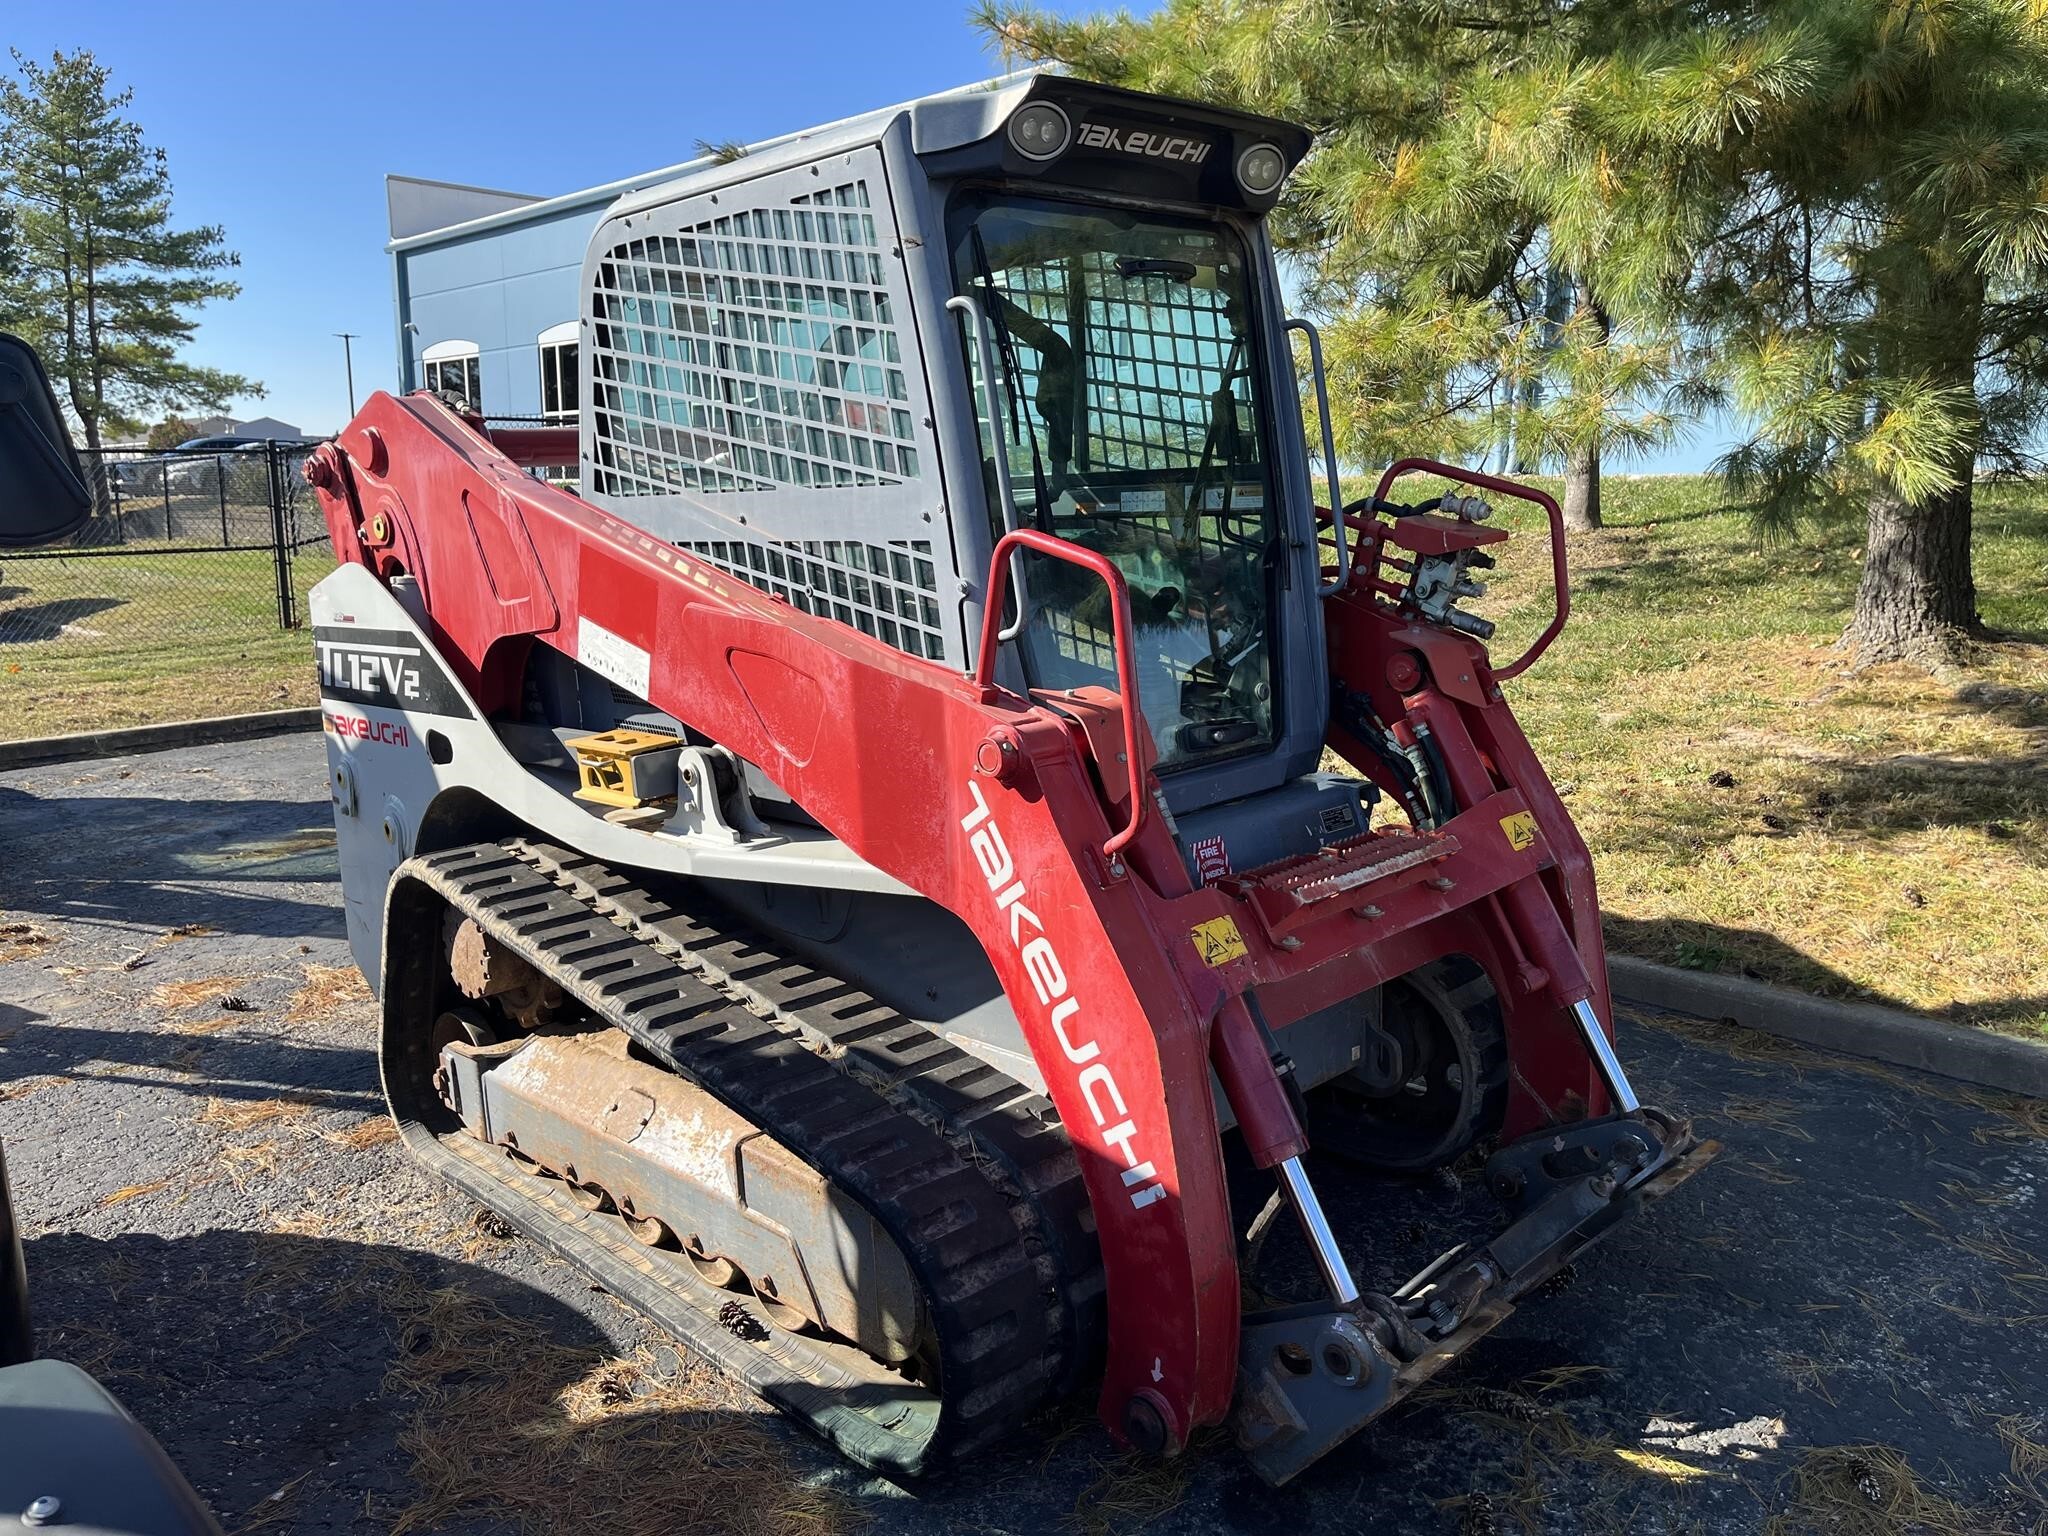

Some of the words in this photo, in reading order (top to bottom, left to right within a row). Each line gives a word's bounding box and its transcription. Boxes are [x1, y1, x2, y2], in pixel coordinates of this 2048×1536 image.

[1078, 122, 1211, 163] TAKEUCHI
[1200, 846, 1219, 859] FIRE
[1205, 867, 1226, 879] INSIDE
[961, 779, 1167, 1209] TAKEUCHI
